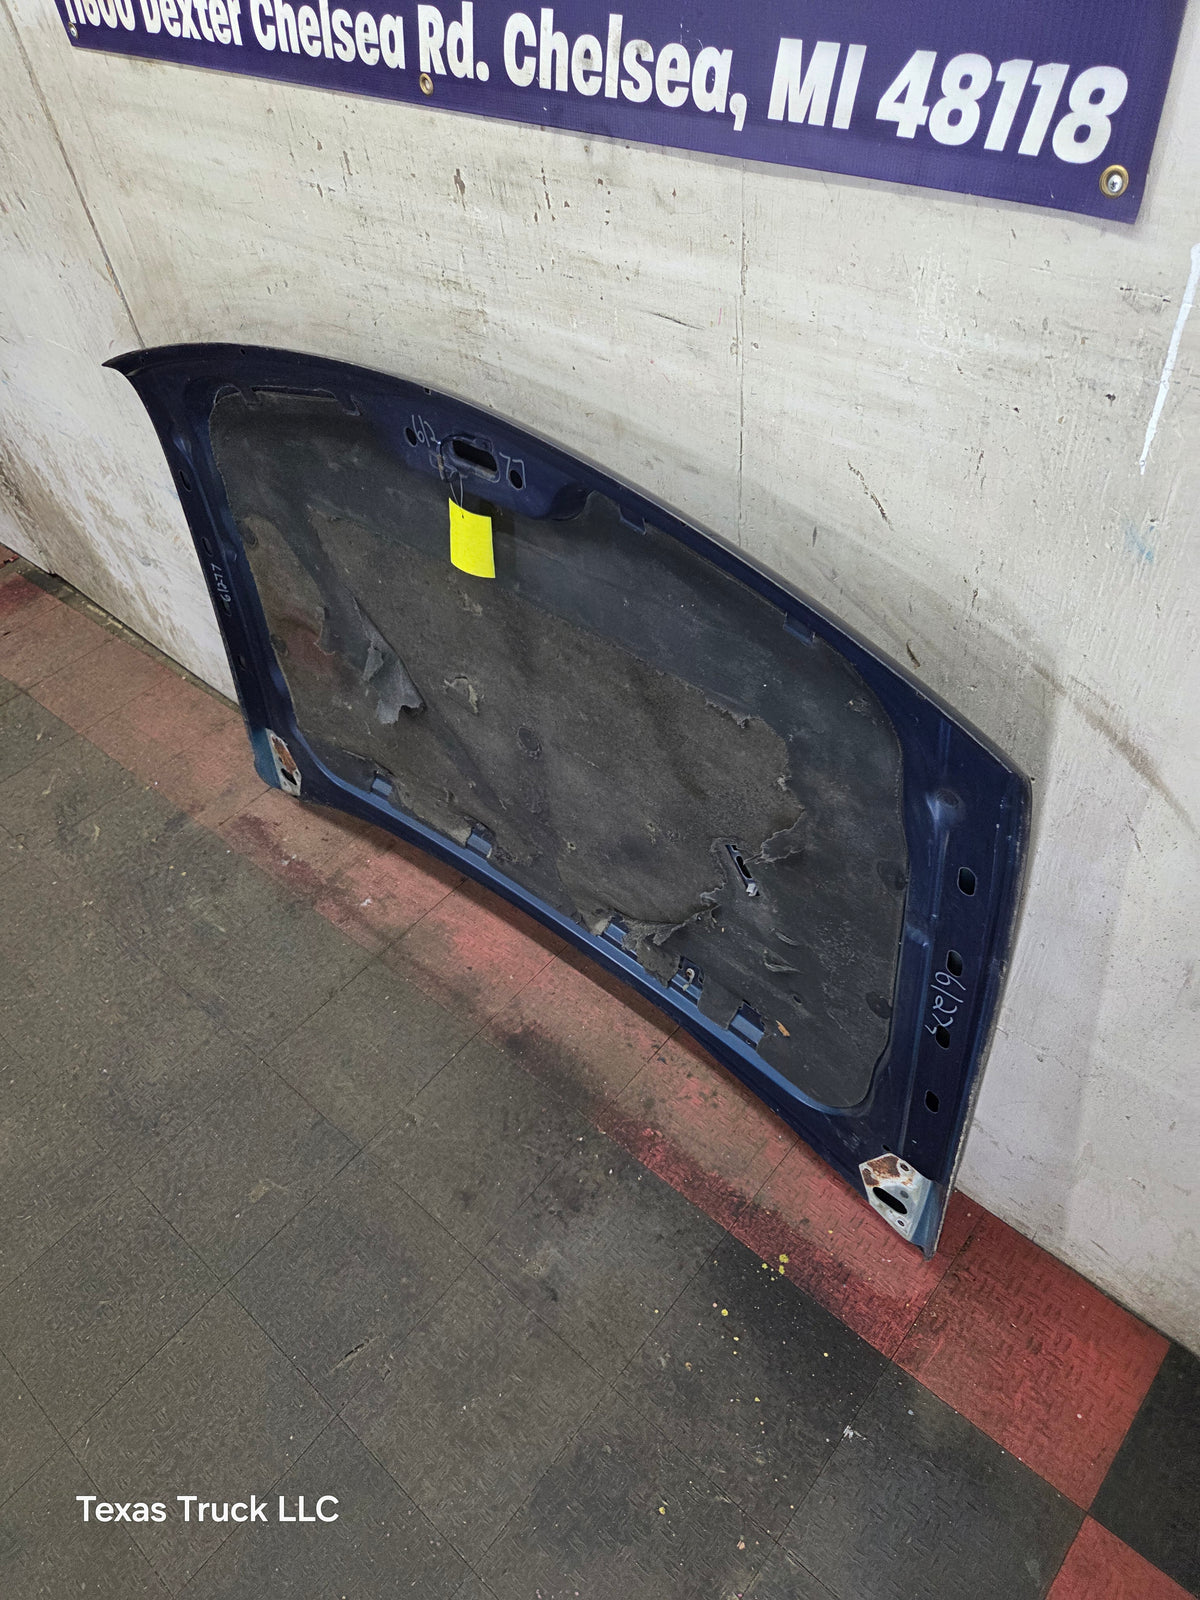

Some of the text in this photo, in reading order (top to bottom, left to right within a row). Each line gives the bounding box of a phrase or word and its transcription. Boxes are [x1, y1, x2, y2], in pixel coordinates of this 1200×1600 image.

[140, 0, 244, 46] Dexter
[250, 0, 406, 70] Chelsea
[417, 1, 491, 83] Rd.
[503, 7, 747, 131] Chelsea,
[767, 37, 868, 130] MI
[875, 49, 1129, 164] 48118
